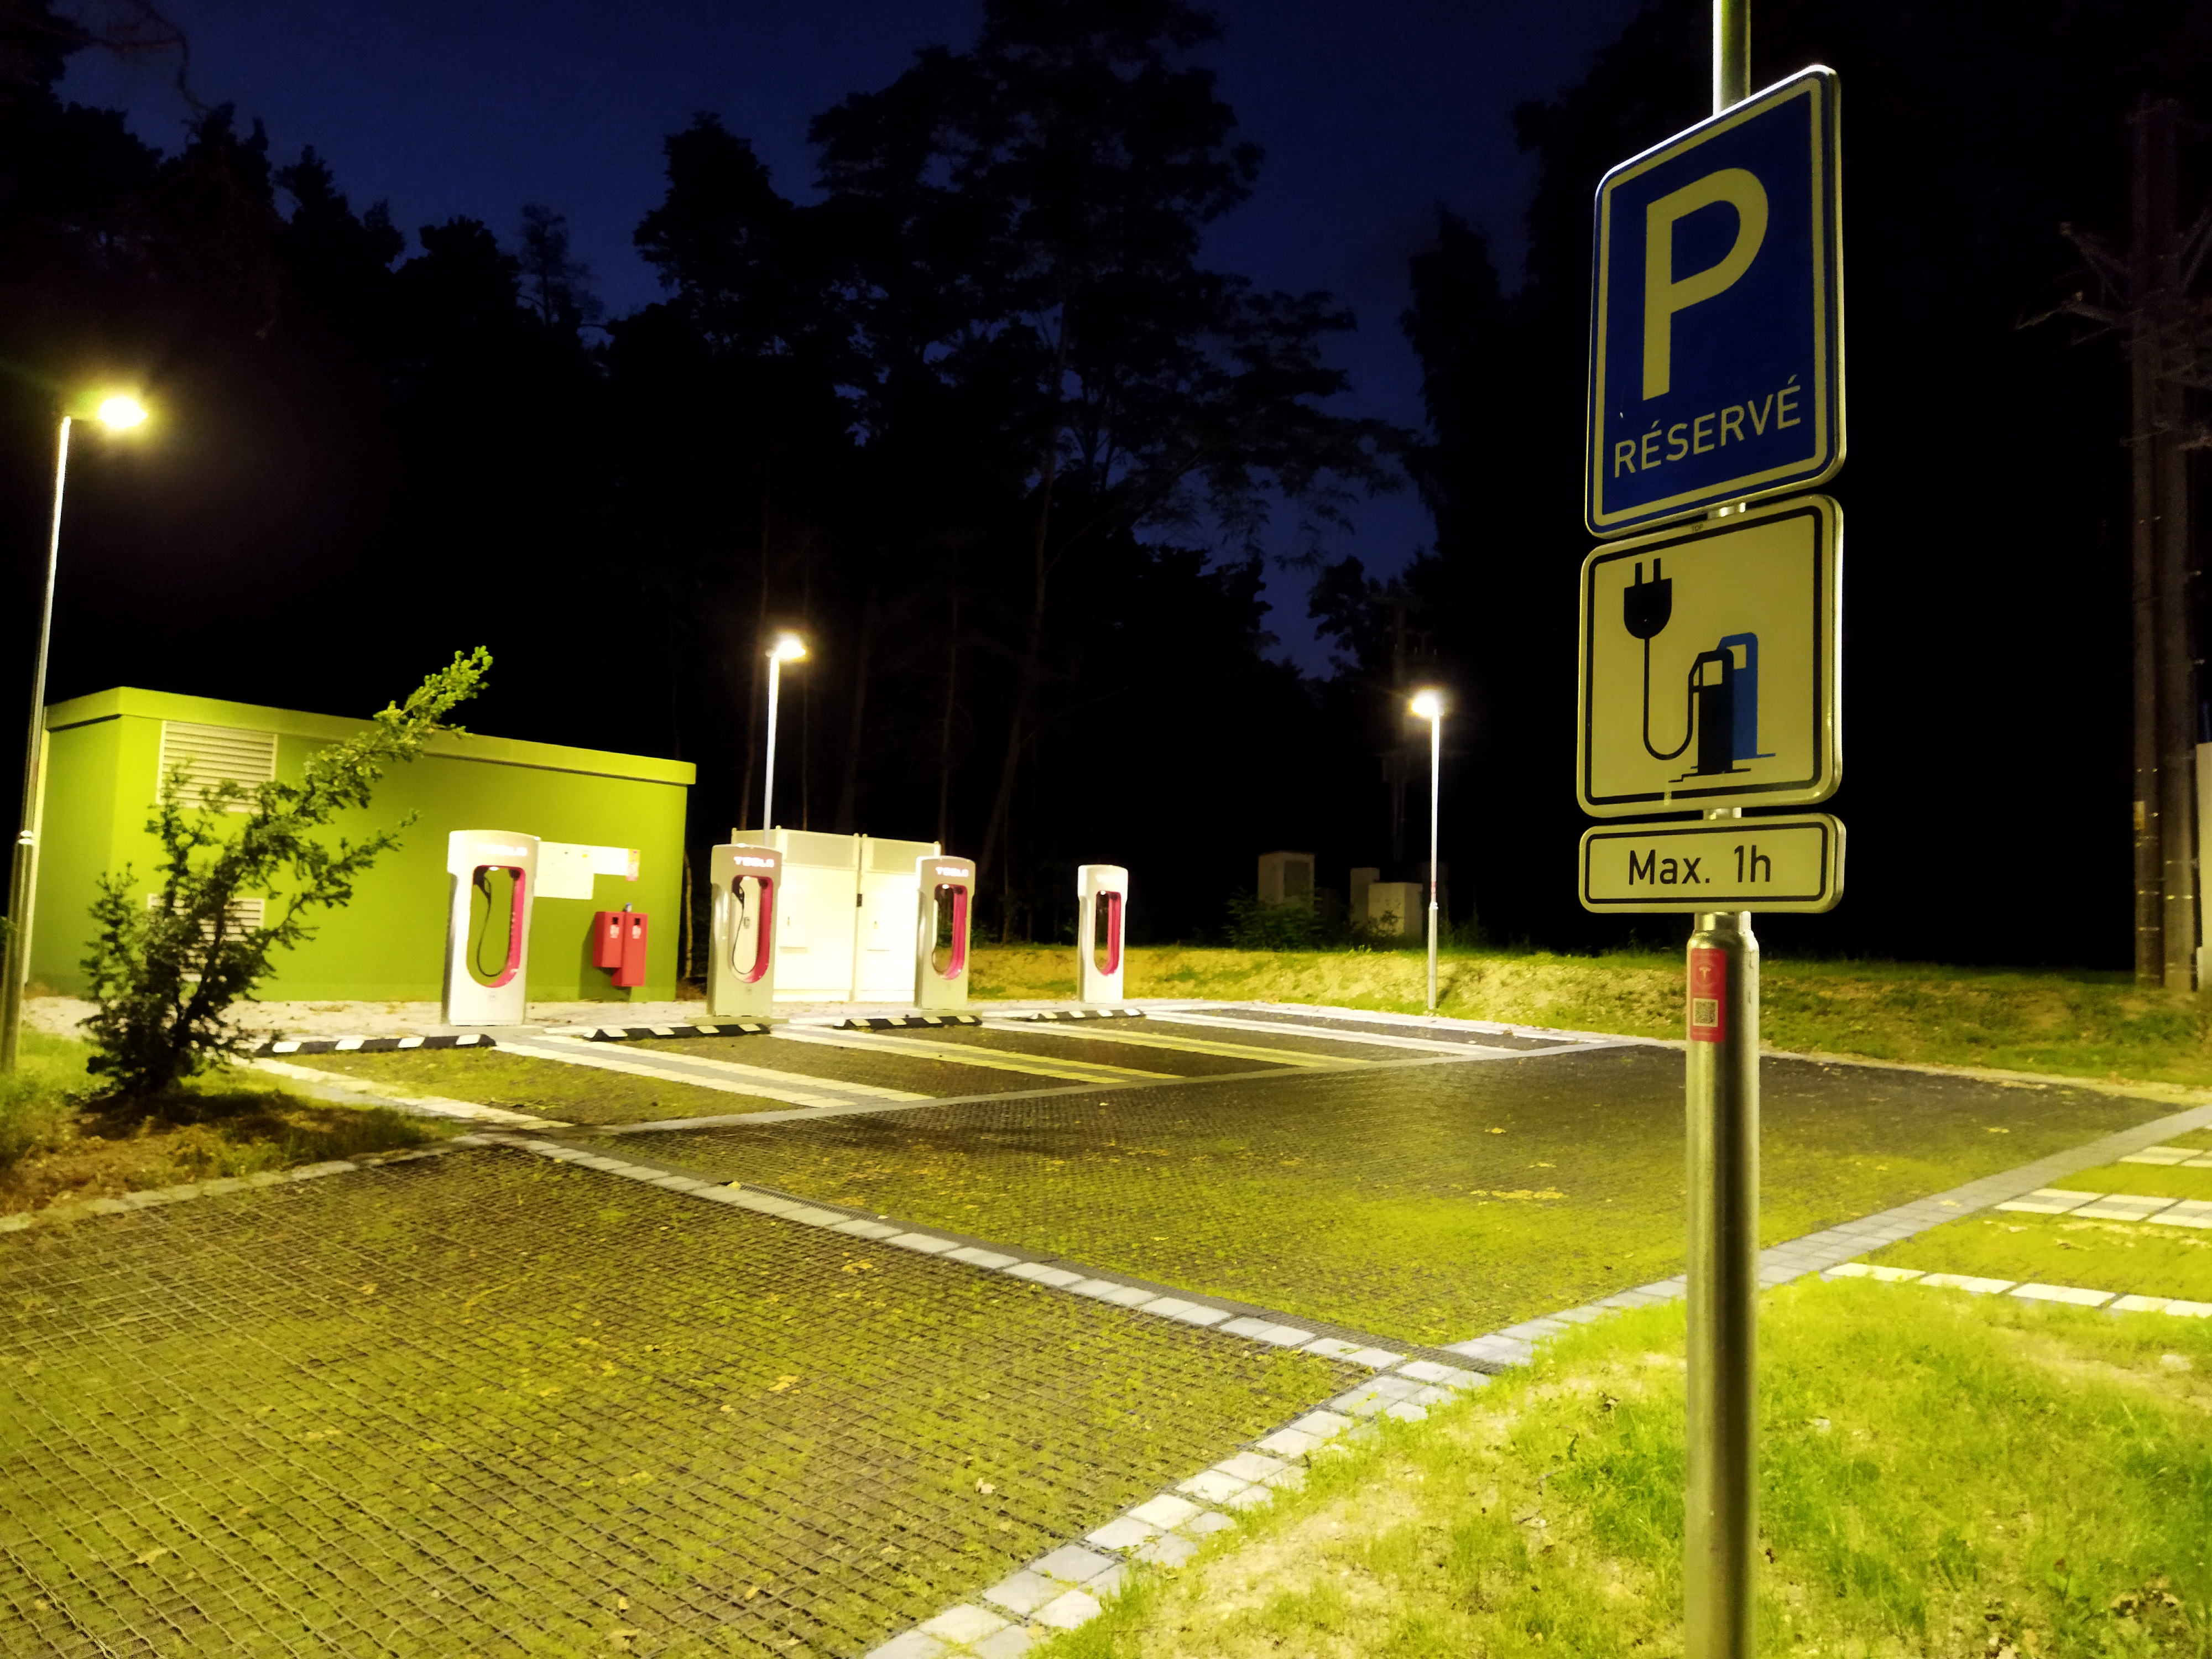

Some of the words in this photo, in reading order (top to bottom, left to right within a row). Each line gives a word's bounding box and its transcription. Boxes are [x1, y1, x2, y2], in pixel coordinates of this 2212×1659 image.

[1642, 168, 1769, 400] P
[1614, 374, 1801, 478] RÉSERVÉ
[1628, 849, 1710, 885] Max.
[1734, 845, 1771, 883] 1h
